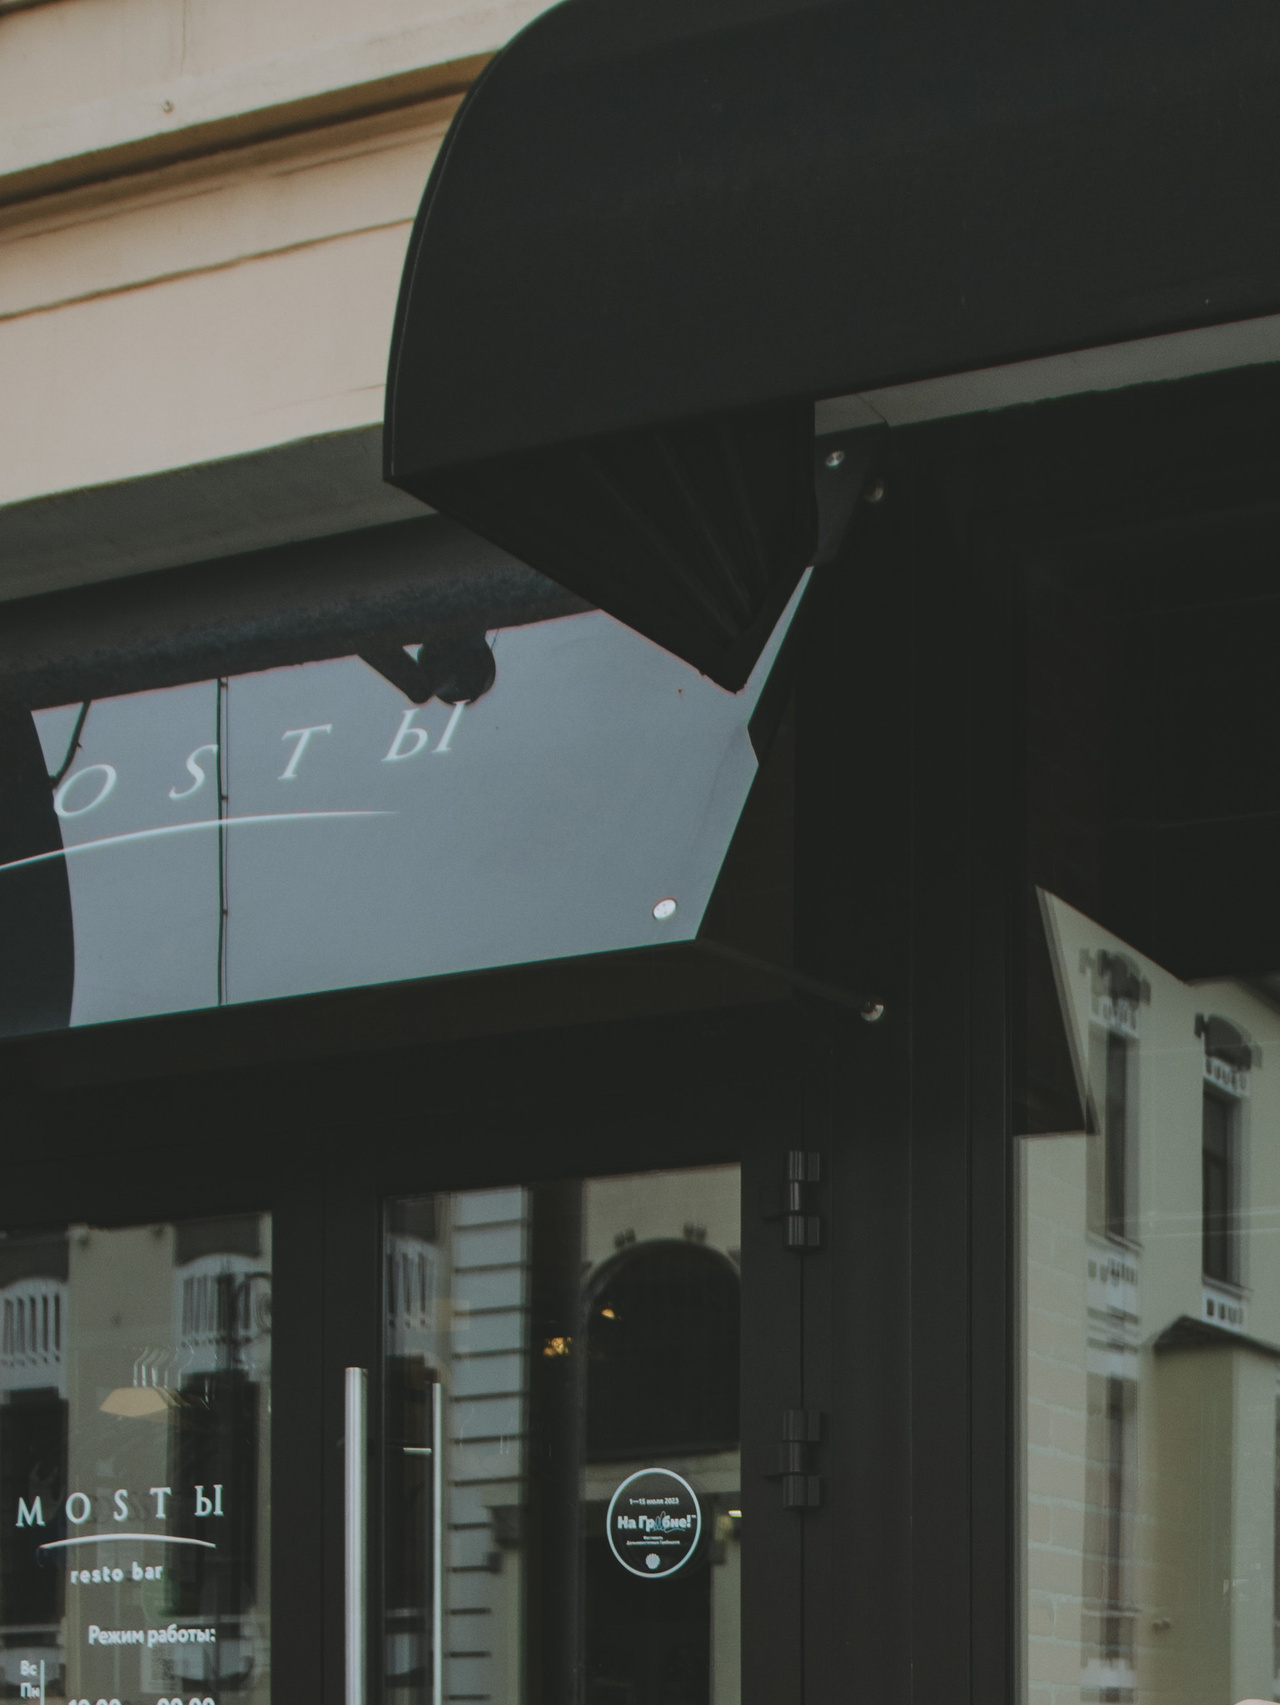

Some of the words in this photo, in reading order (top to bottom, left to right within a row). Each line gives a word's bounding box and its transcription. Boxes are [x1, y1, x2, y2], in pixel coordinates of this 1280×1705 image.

[617, 1515, 636, 1529] На
[70, 1566, 124, 1584] resto
[132, 1561, 163, 1581] bar
[88, 1625, 144, 1645] Режим
[147, 1624, 216, 1648] работы:
[20, 1660, 38, 1676] Вс
[20, 1682, 41, 1700] Пн
